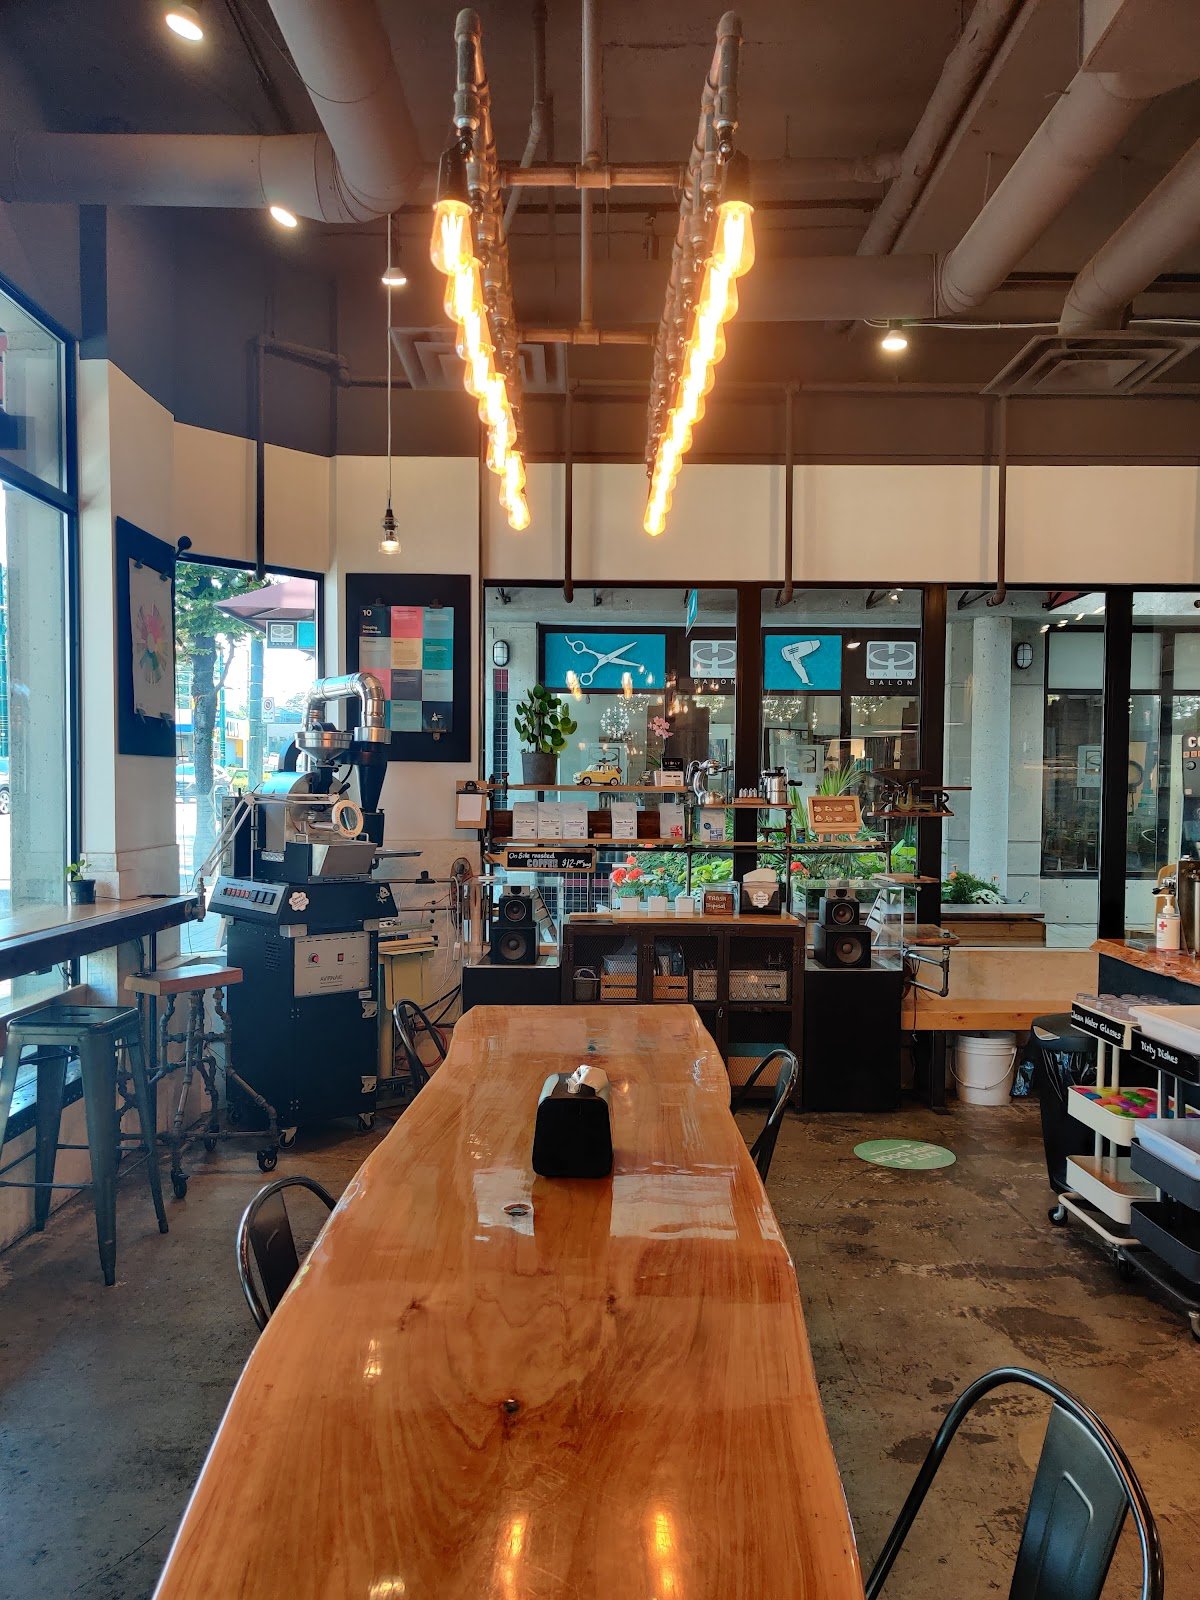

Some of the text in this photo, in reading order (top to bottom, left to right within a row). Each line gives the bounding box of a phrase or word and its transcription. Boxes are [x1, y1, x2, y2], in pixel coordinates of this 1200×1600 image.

[362, 609, 372, 617] 10
[526, 859, 559, 868] COFFEE
[1084, 1016, 1098, 1029] Water
[1099, 1022, 1122, 1040] Glasses
[1140, 1041, 1179, 1064] Dirty Dishes
